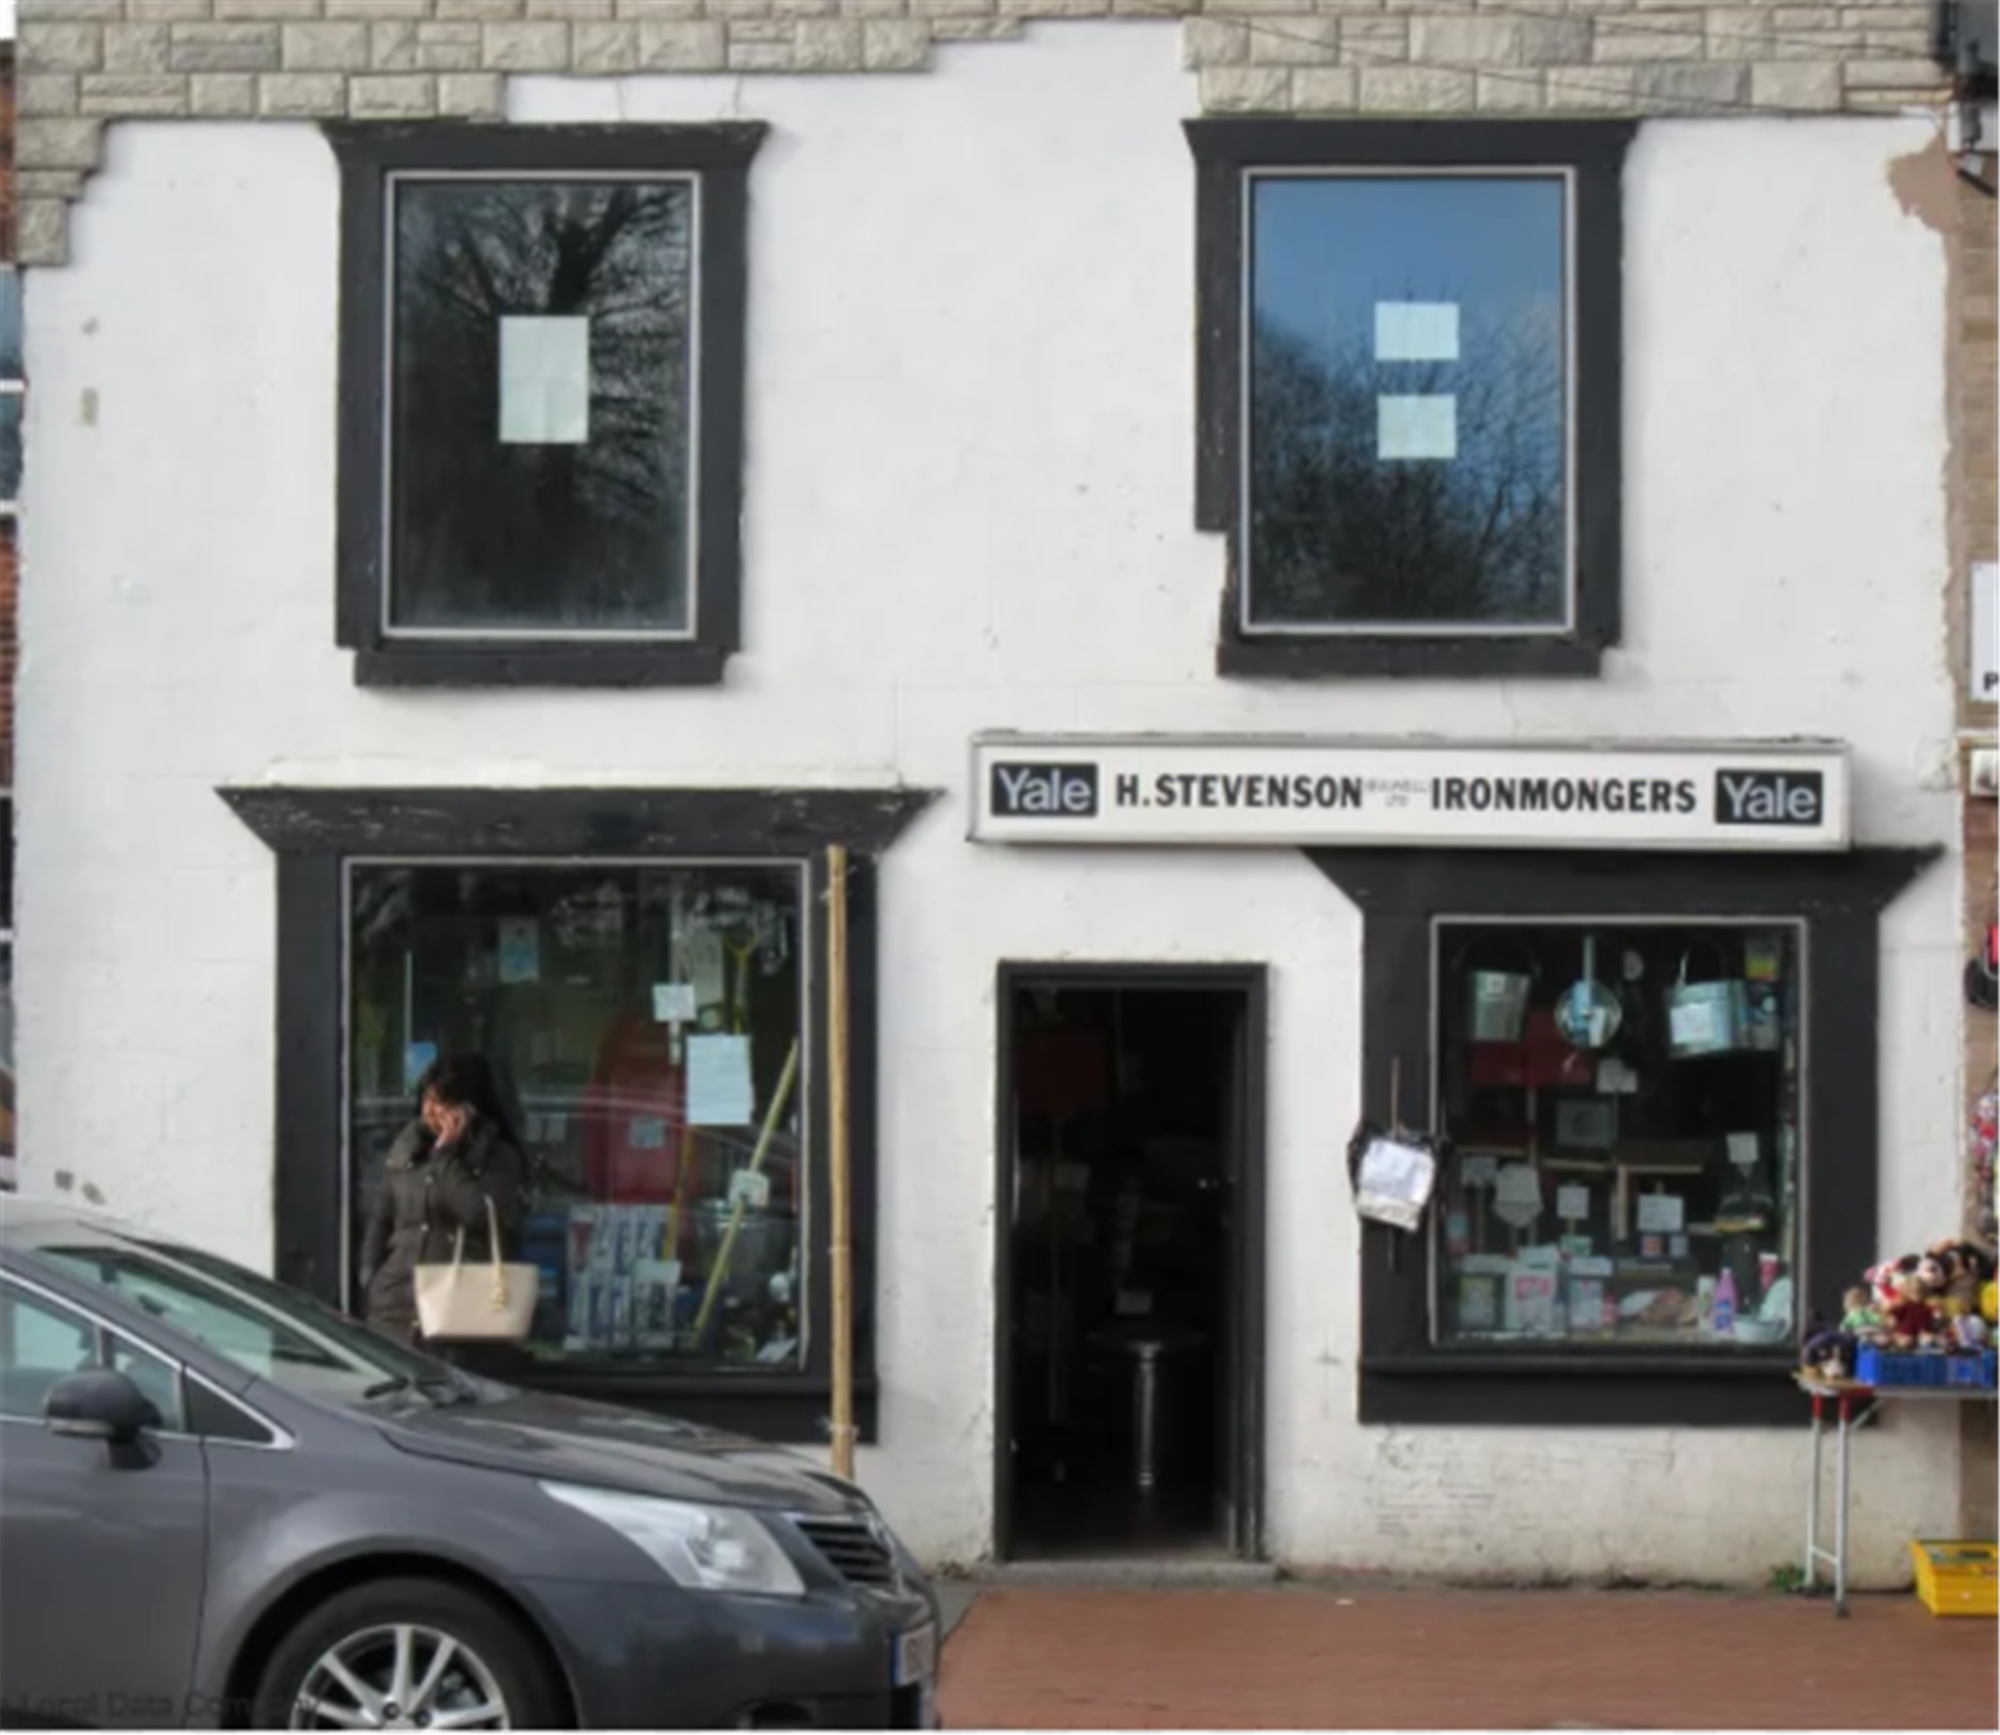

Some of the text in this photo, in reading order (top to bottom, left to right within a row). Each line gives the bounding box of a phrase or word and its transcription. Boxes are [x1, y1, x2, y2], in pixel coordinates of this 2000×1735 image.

[998, 767, 1092, 812] Yale
[1431, 776, 1698, 813] IRONMONGERS
[1720, 774, 1818, 820] Yale
